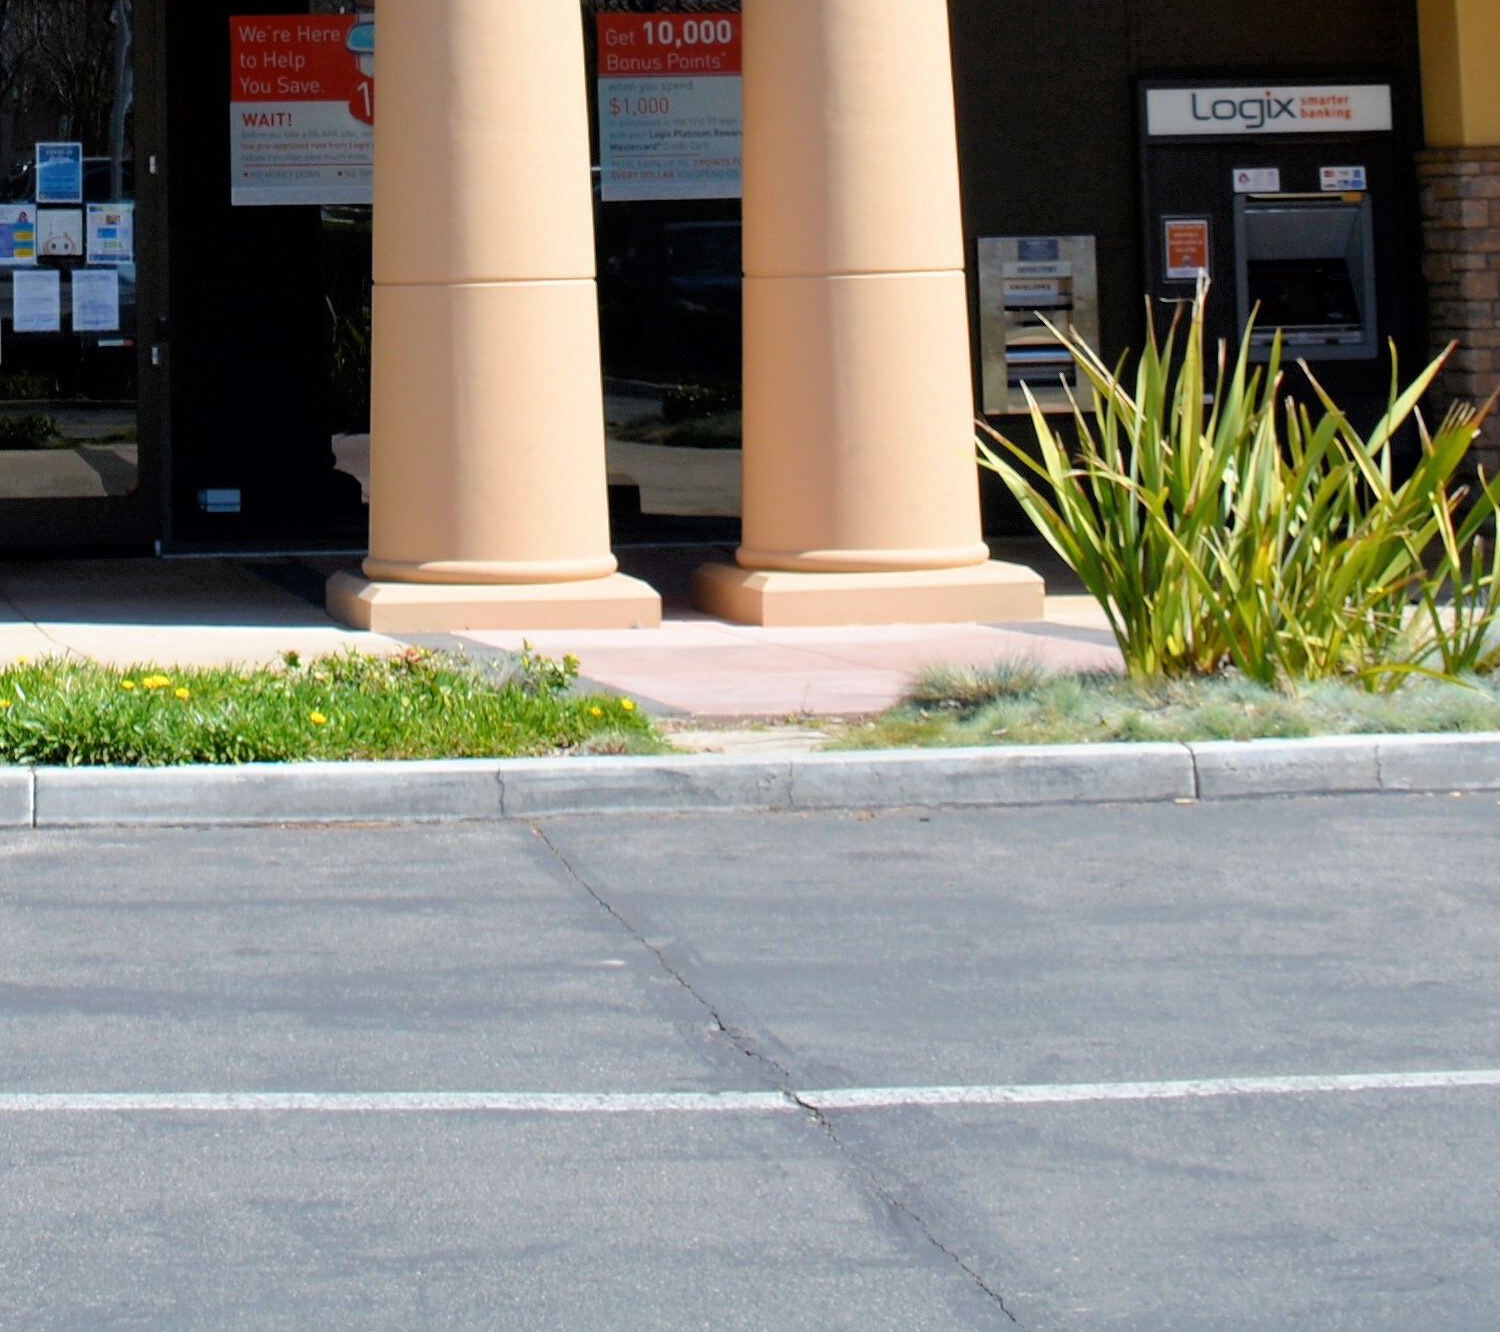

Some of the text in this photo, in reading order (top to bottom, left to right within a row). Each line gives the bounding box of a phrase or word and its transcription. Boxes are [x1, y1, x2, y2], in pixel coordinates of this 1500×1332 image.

[238, 24, 341, 43] We're Here
[605, 19, 732, 49] Get 10,000
[240, 51, 306, 72] to Help
[606, 54, 663, 71] Bonus
[240, 76, 326, 94] You Save.
[609, 97, 669, 116] $1,000
[1300, 94, 1349, 106] smarter
[1191, 90, 1297, 129] Logix
[1300, 106, 1352, 120] banking
[242, 112, 293, 127] WAIT!
